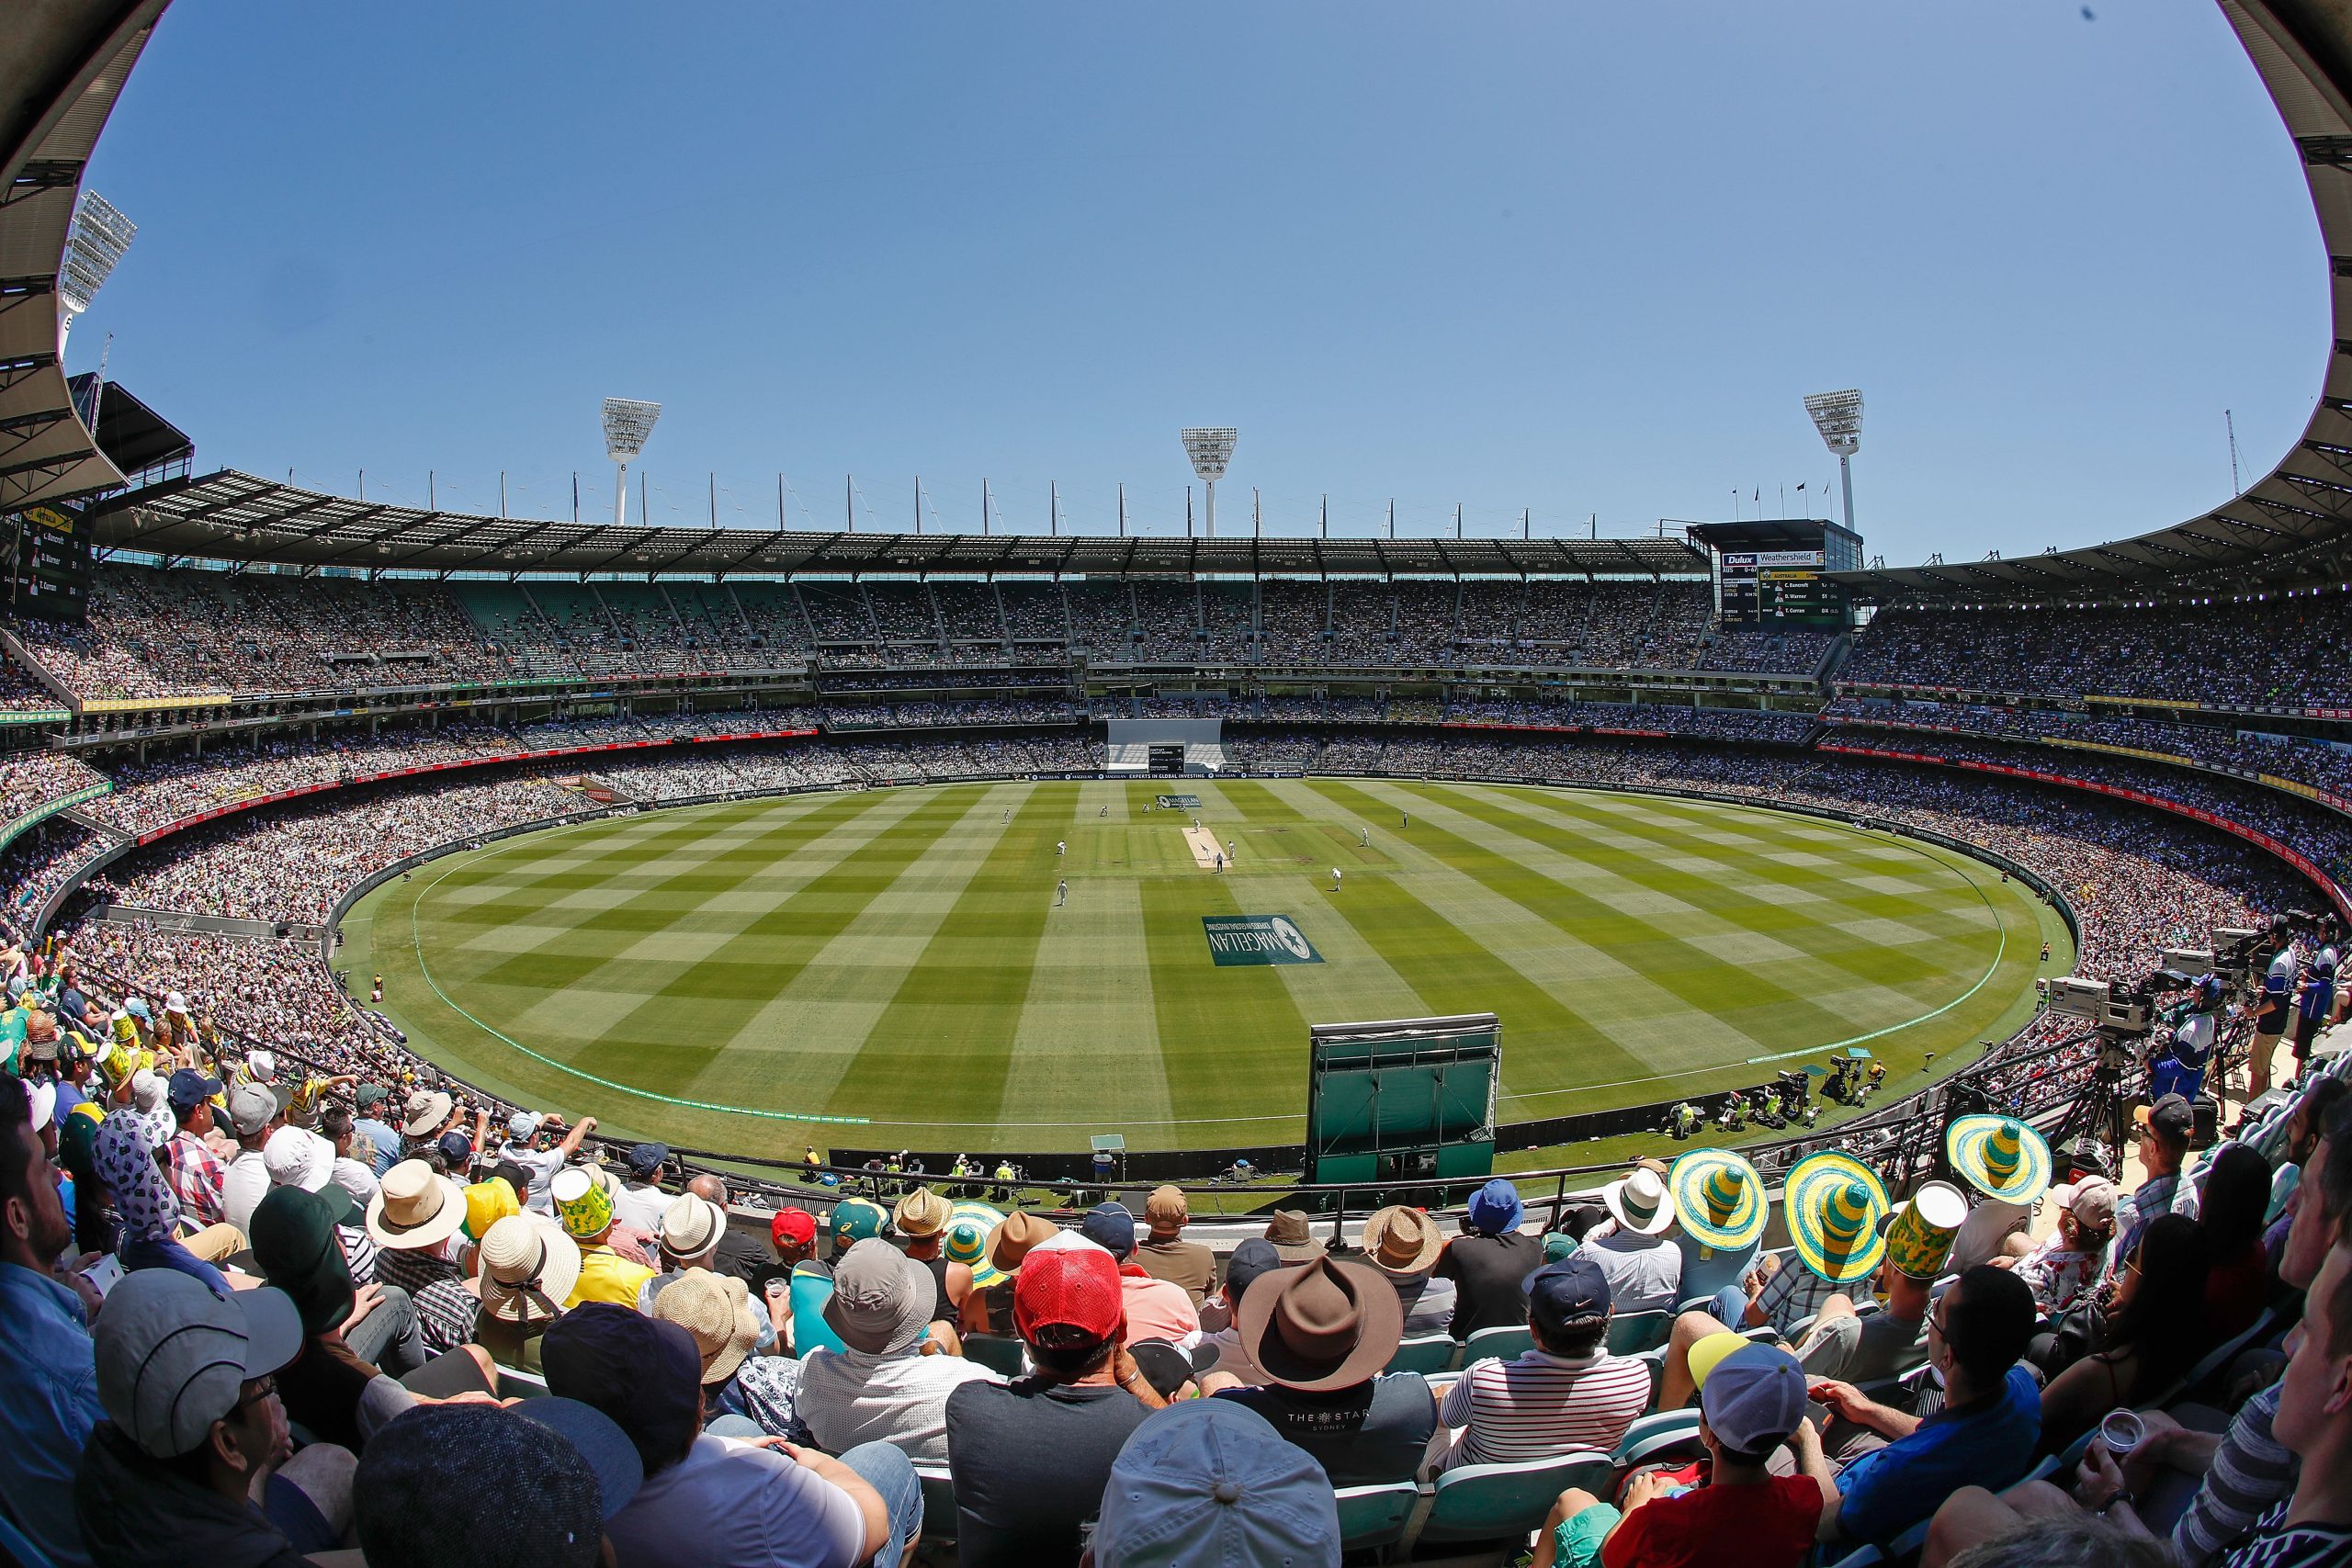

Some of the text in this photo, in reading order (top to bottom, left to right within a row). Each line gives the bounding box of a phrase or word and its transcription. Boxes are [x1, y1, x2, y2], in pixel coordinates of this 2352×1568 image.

[588, 791, 612, 800] GATORADE
[1930, 834, 1944, 843] CAUGHT
[1209, 932, 1284, 952] MAGELLAN
[1288, 1409, 1370, 1422] THE STAR
